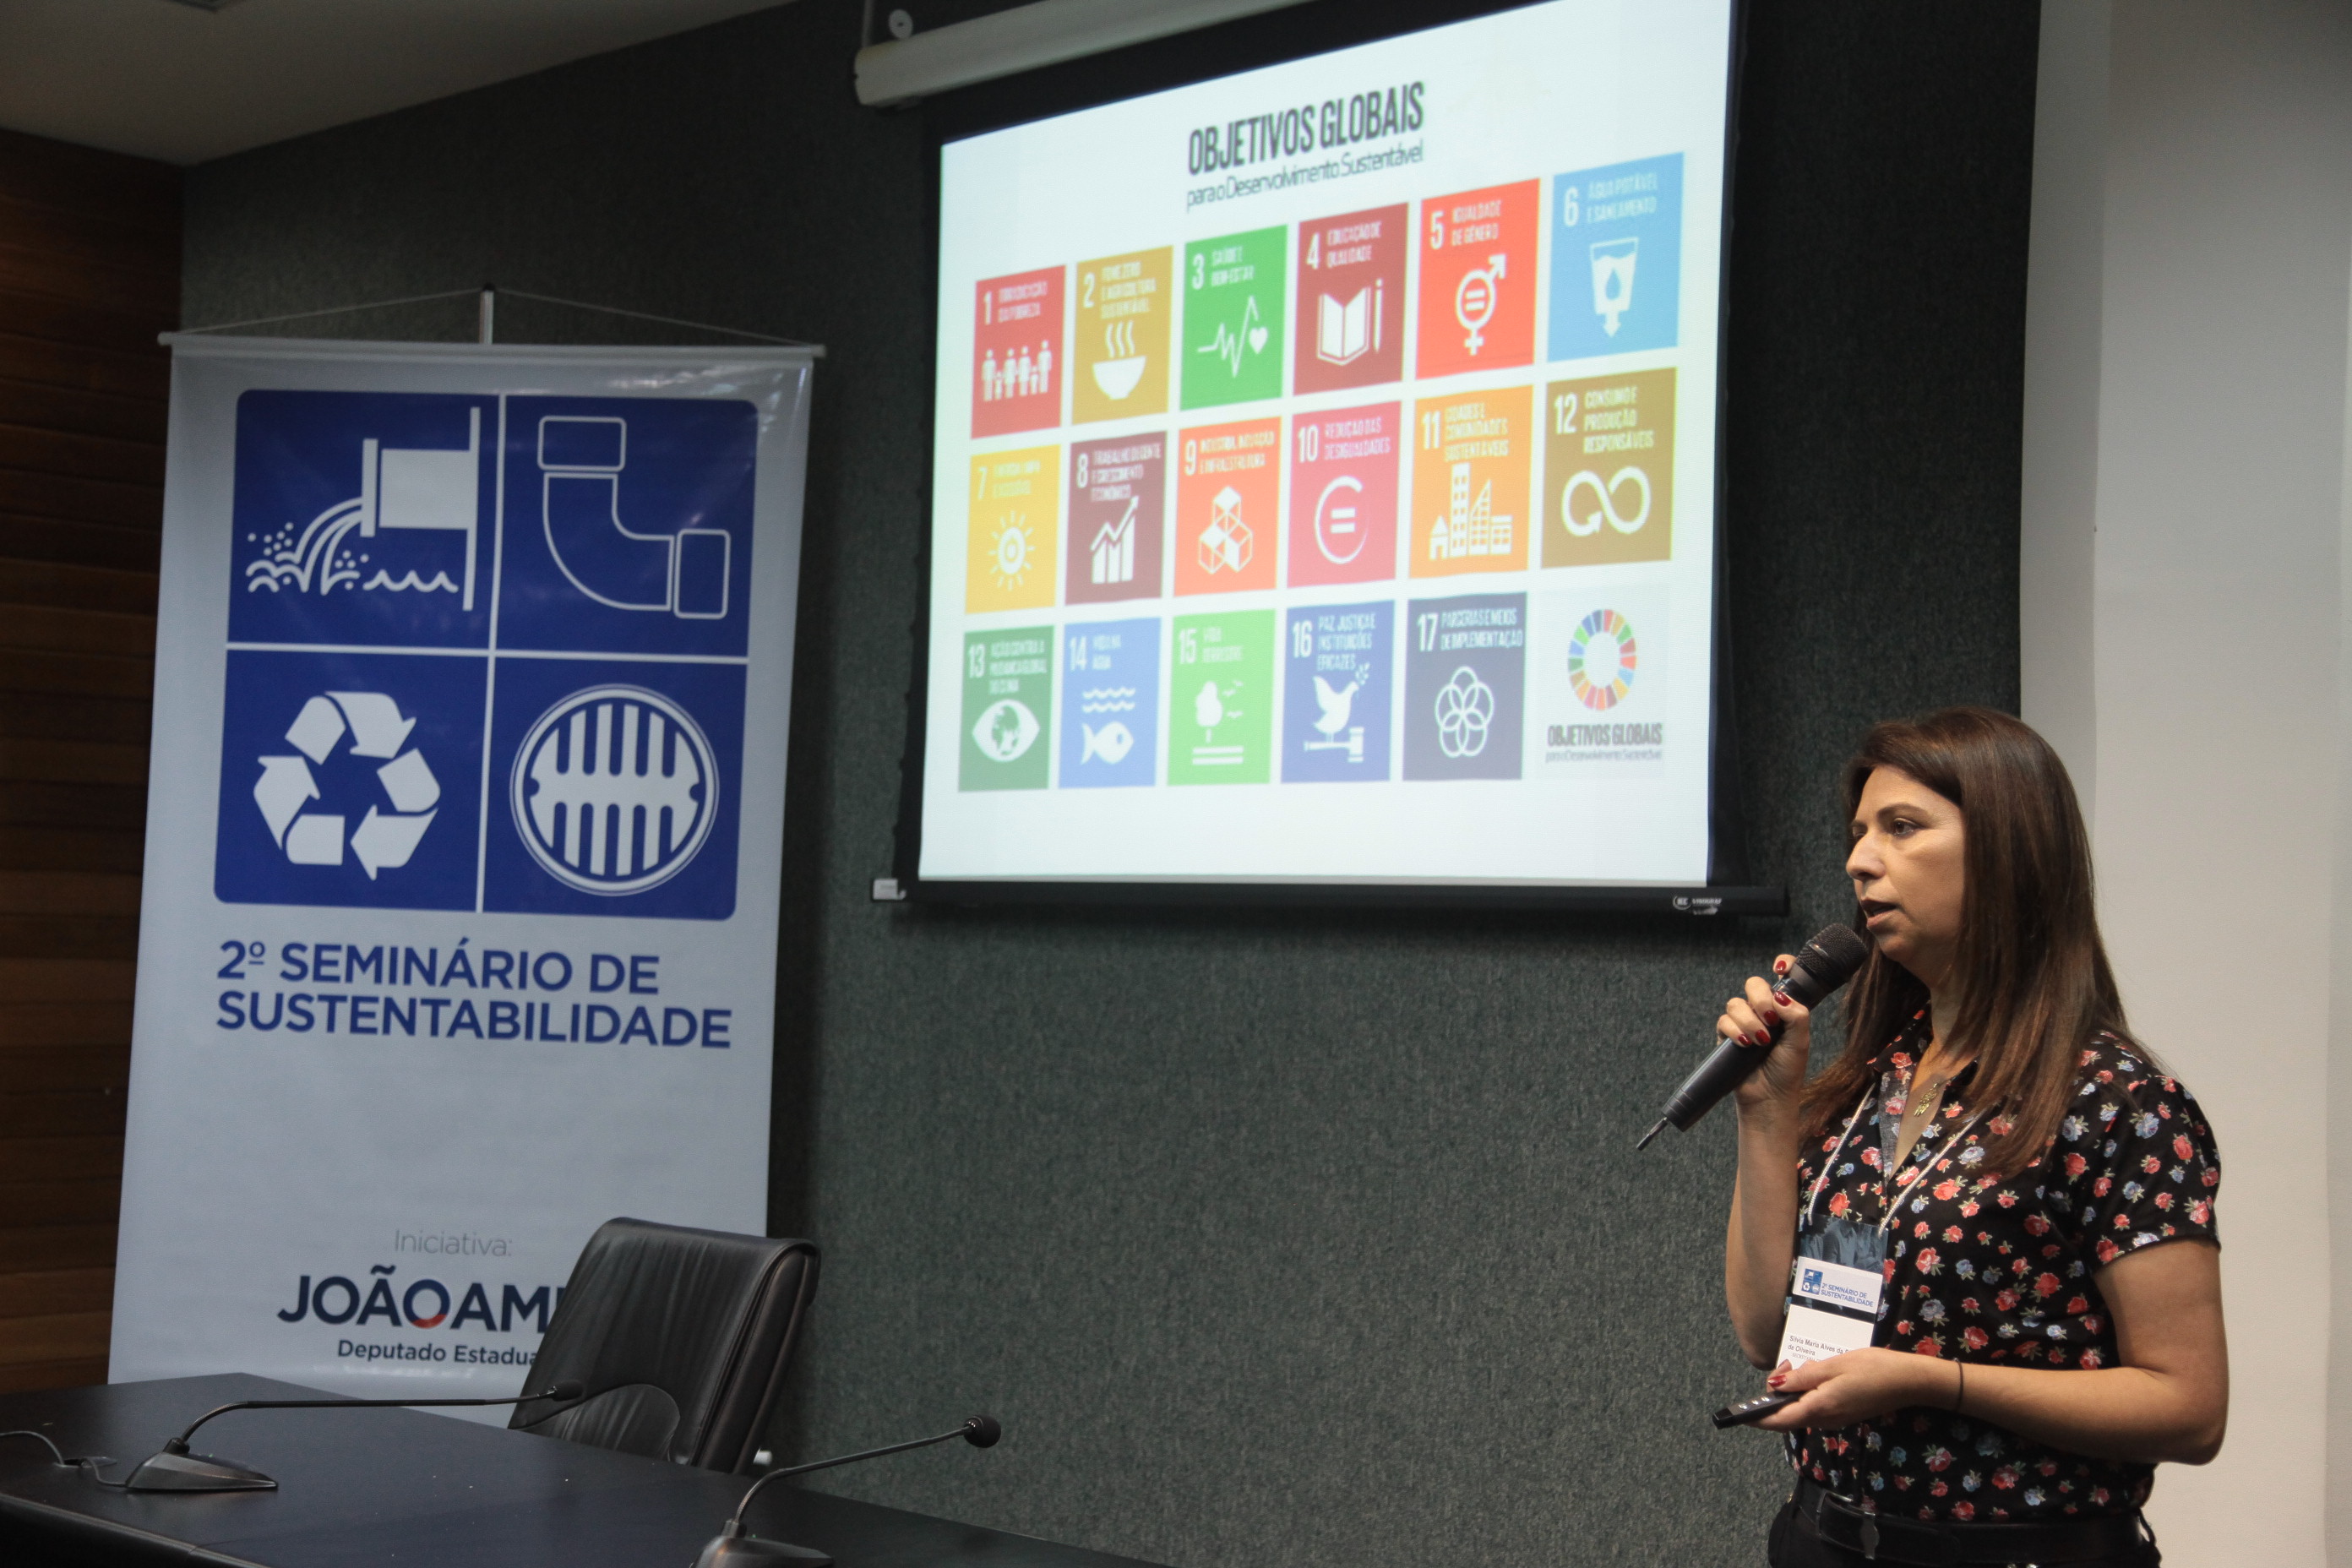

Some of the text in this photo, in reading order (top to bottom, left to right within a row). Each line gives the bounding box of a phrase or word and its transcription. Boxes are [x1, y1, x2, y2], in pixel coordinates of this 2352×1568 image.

[1188, 80, 1424, 176] OBJETIVOS GLOBAIS
[1186, 139, 1424, 214] para o Desenvolvimento Sustentável
[1564, 186, 1579, 227] 6
[1431, 210, 1445, 250] 5
[1306, 231, 1320, 270] 4
[1082, 272, 1096, 308] 2
[1191, 253, 1205, 291] 3
[983, 291, 993, 325] 1
[1422, 411, 1440, 449] 11
[1554, 392, 1578, 434] 12
[1184, 438, 1197, 476] 9
[1298, 424, 1319, 463] 10
[977, 466, 988, 500] 7
[1076, 453, 1088, 488] 8
[1179, 628, 1198, 665] 15
[1293, 619, 1312, 659] 16
[1418, 612, 1439, 652] 17
[968, 642, 985, 678] 13
[1070, 634, 1087, 672] 14
[1547, 722, 1663, 747] OBJETIVOS GLOBAIS
[216, 937, 661, 995] 2º SEMINÁRIO DE
[216, 990, 732, 1049] SUSTENTABILIDADE
[1821, 1289, 1874, 1307] SUSTENTABILIDADE
[1828, 1284, 1859, 1297] SEMINÁRIO
[1859, 1291, 1868, 1299] DE
[337, 1340, 447, 1363] Deputado
[1805, 1339, 1820, 1348] Maria
